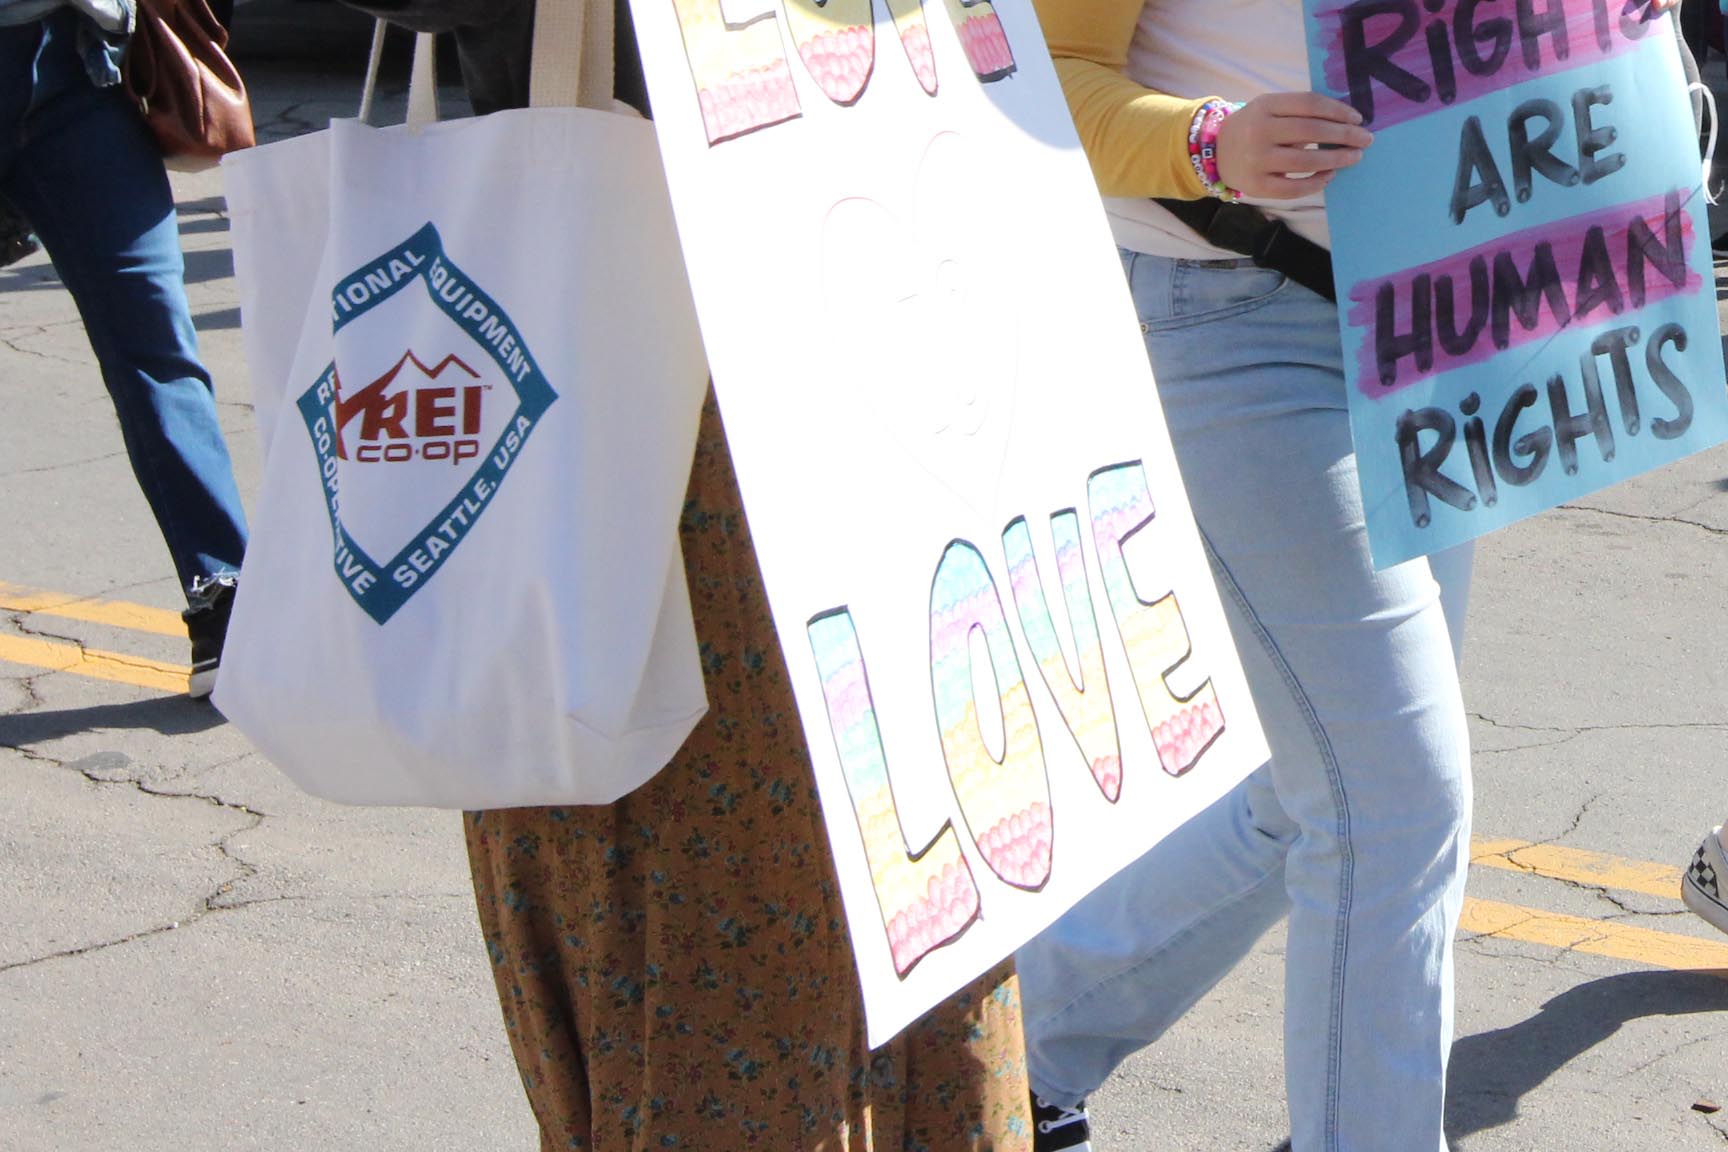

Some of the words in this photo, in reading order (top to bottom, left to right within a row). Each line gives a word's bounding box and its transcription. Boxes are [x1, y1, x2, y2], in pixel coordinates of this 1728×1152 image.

[1449, 84, 1627, 226] ARE
[428, 255, 532, 384] EQUIPMENT
[1375, 186, 1688, 387] HUMAN
[359, 384, 483, 442] REI
[392, 478, 497, 590] SEATTLE,
[492, 413, 532, 472] USA
[806, 458, 1226, 981] LOVE
